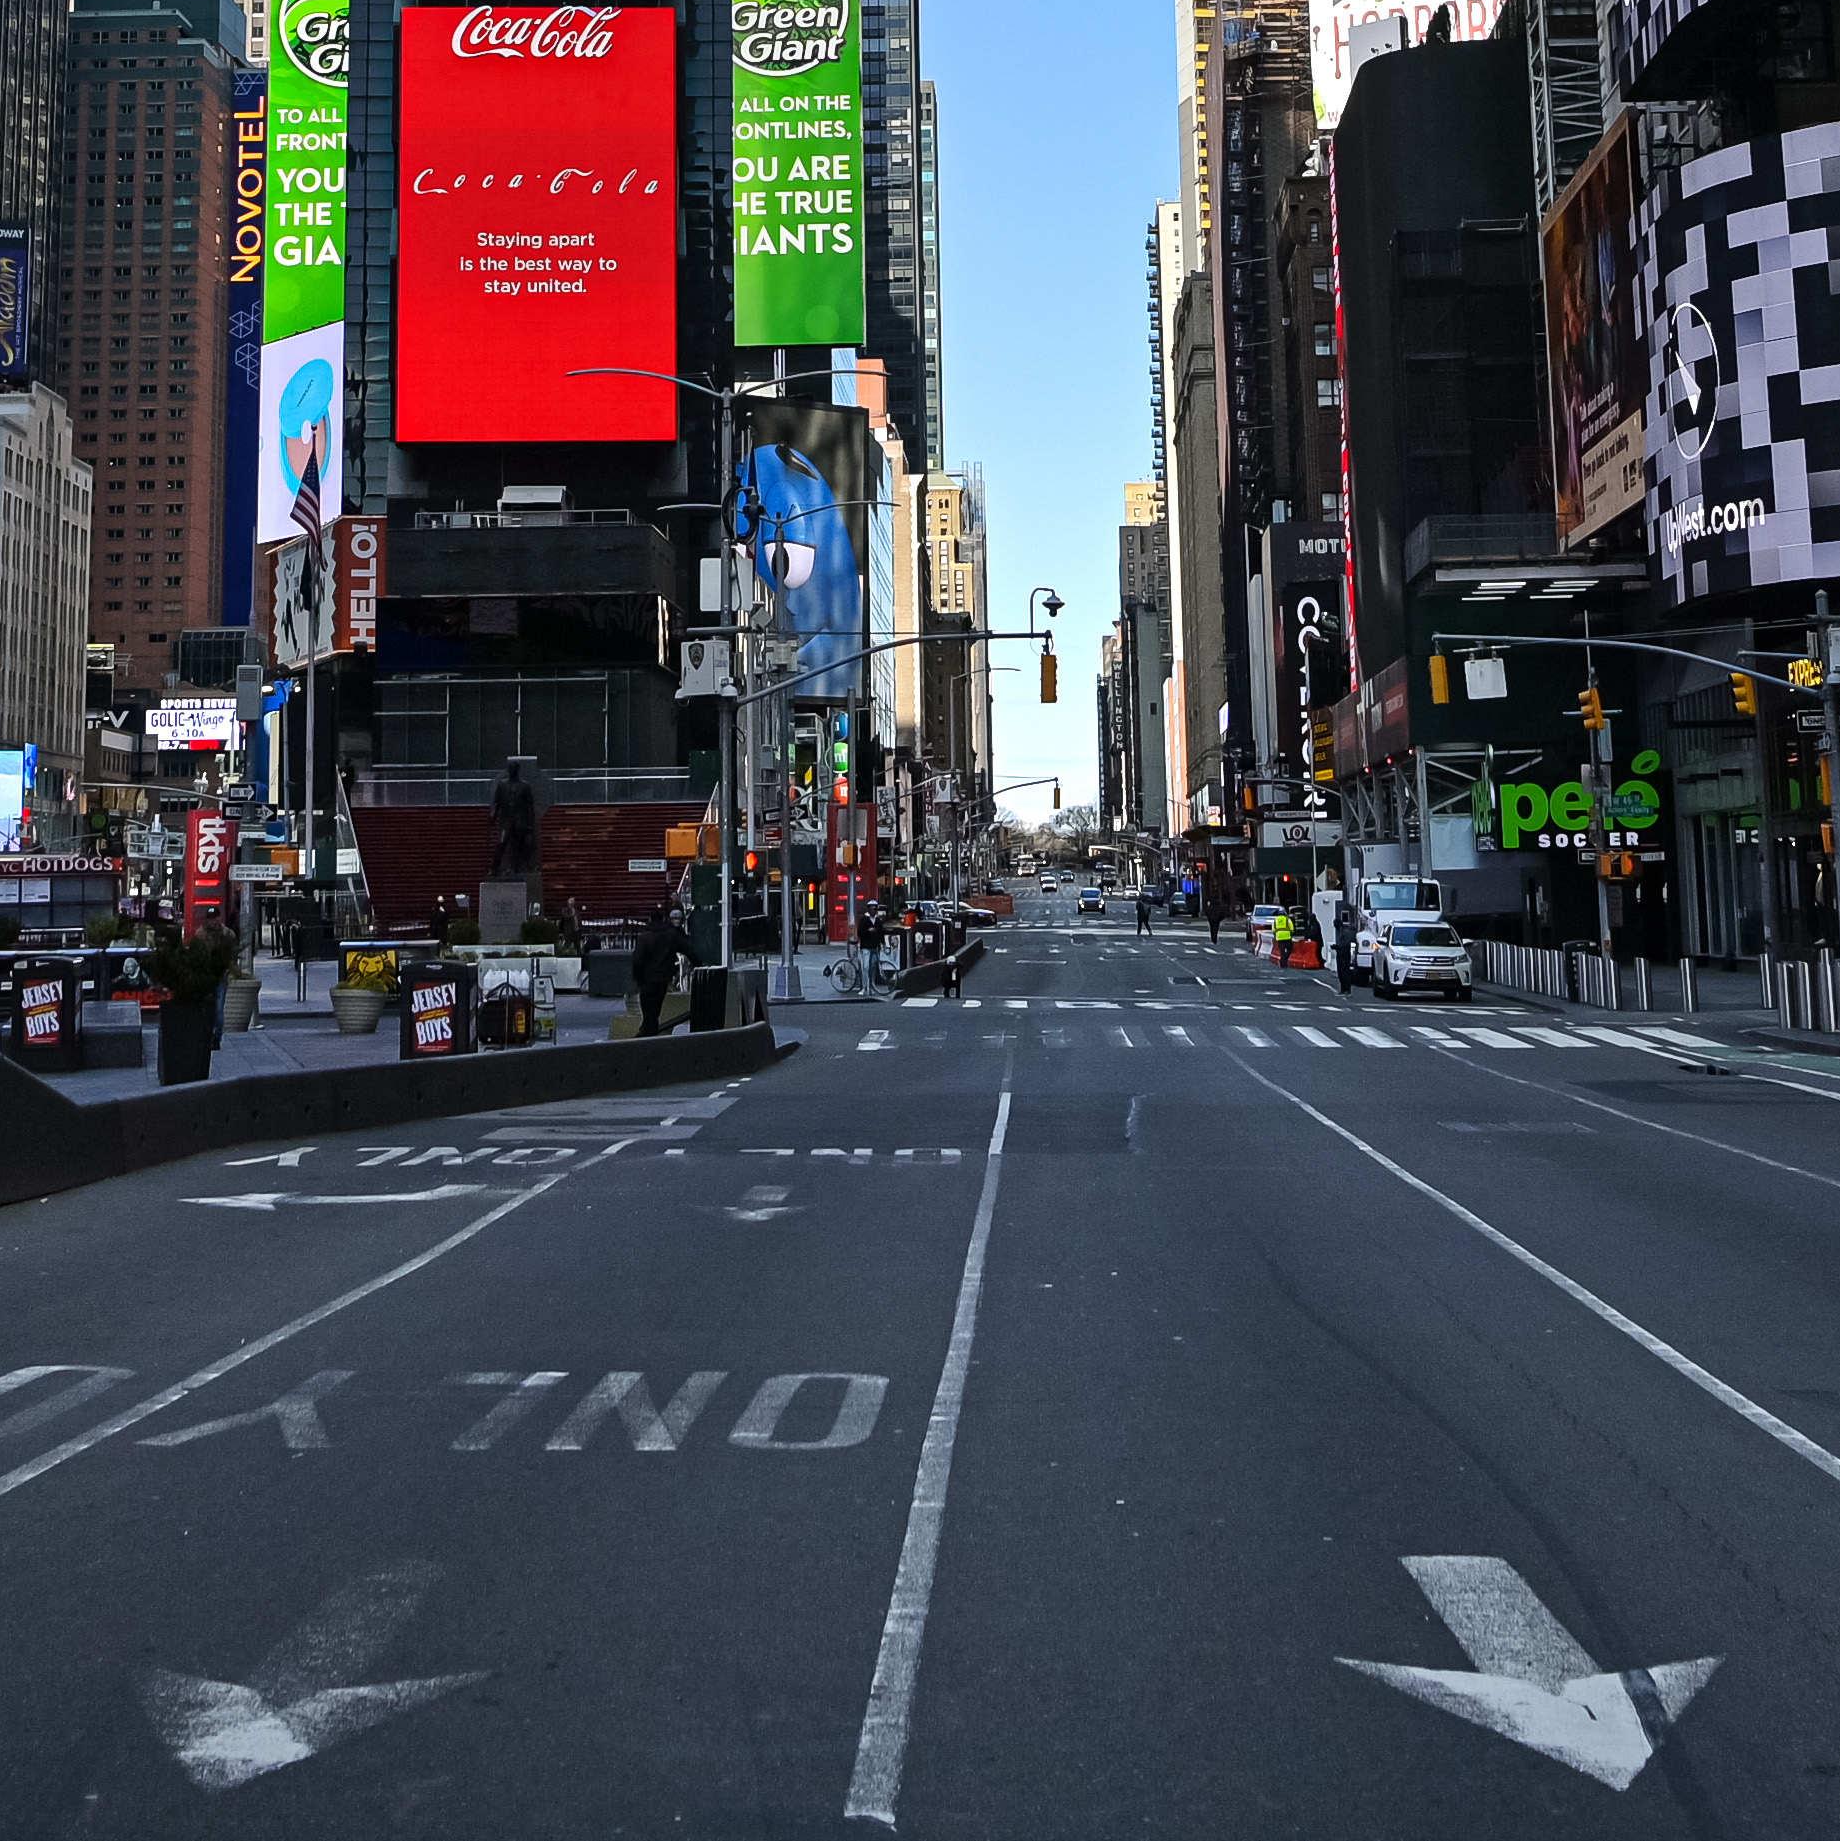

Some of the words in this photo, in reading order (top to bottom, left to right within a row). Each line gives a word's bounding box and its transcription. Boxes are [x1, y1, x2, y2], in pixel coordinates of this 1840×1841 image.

[451, 5, 622, 58] Coca-Cola
[732, 1, 839, 32] Green
[740, 31, 844, 63] Giant
[277, 109, 303, 125] TO
[308, 108, 343, 123] ALL
[739, 96, 775, 113] ALL
[779, 95, 809, 112] ON
[813, 95, 851, 111] THE
[277, 166, 346, 194] YOU
[788, 154, 851, 182] ARE
[231, 96, 265, 282] NOVOTEL
[774, 189, 853, 215] TRUE
[274, 202, 333, 227] THE
[273, 235, 342, 267] GIA
[477, 231, 543, 249] Staying
[548, 232, 596, 249] apart
[459, 256, 474, 271] is
[479, 256, 508, 271] the
[514, 256, 552, 271] best
[558, 259, 593, 274] way
[598, 256, 618, 271] to
[484, 280, 521, 296] stay
[527, 278, 587, 294] united.
[1666, 496, 1766, 559] UpWest.com
[350, 522, 378, 646] HELLO!
[1112, 662, 1124, 749] WELLINGTON
[198, 817, 227, 873] tkts
[1538, 832, 1639, 848] SOCER
[22, 979, 63, 1009] JERSEY
[411, 981, 458, 1015] JERSEY
[26, 1011, 60, 1038] BOYS
[414, 1015, 454, 1047] BOYS
